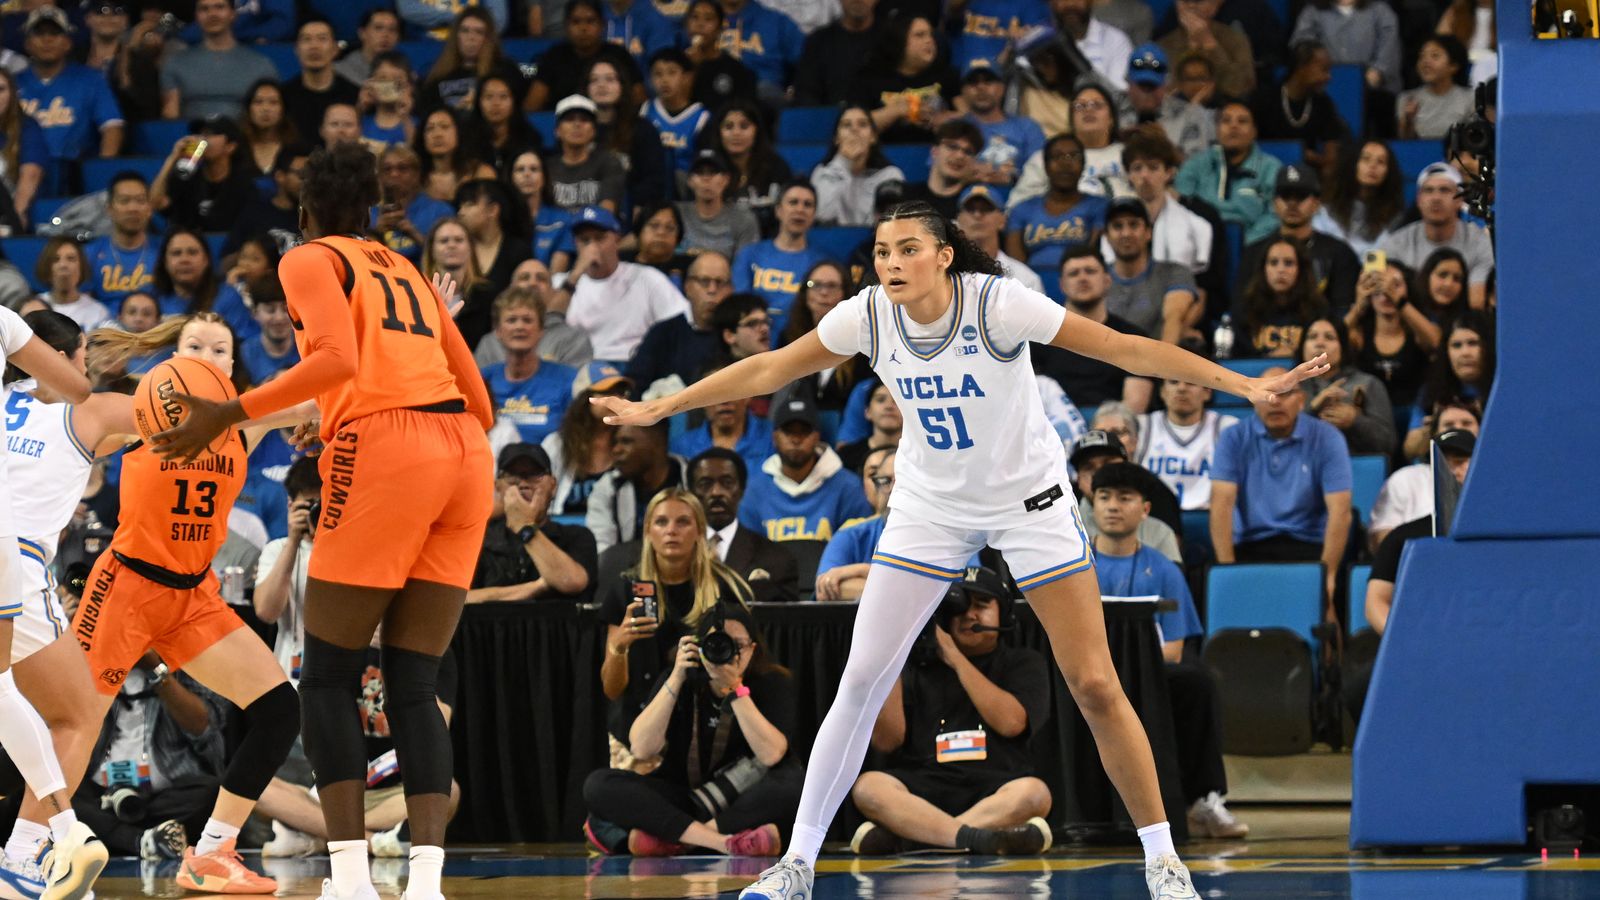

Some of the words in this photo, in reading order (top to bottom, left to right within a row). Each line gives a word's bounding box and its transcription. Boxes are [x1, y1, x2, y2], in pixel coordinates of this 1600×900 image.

[369, 270, 434, 338] 11
[896, 374, 985, 399] UCLA
[917, 407, 974, 450] 51
[323, 430, 358, 530] COWGIRLS
[1149, 456, 1212, 476] UCLA
[171, 479, 218, 518] 13
[171, 522, 212, 541] STATE
[77, 569, 115, 651] COWGIRLS
